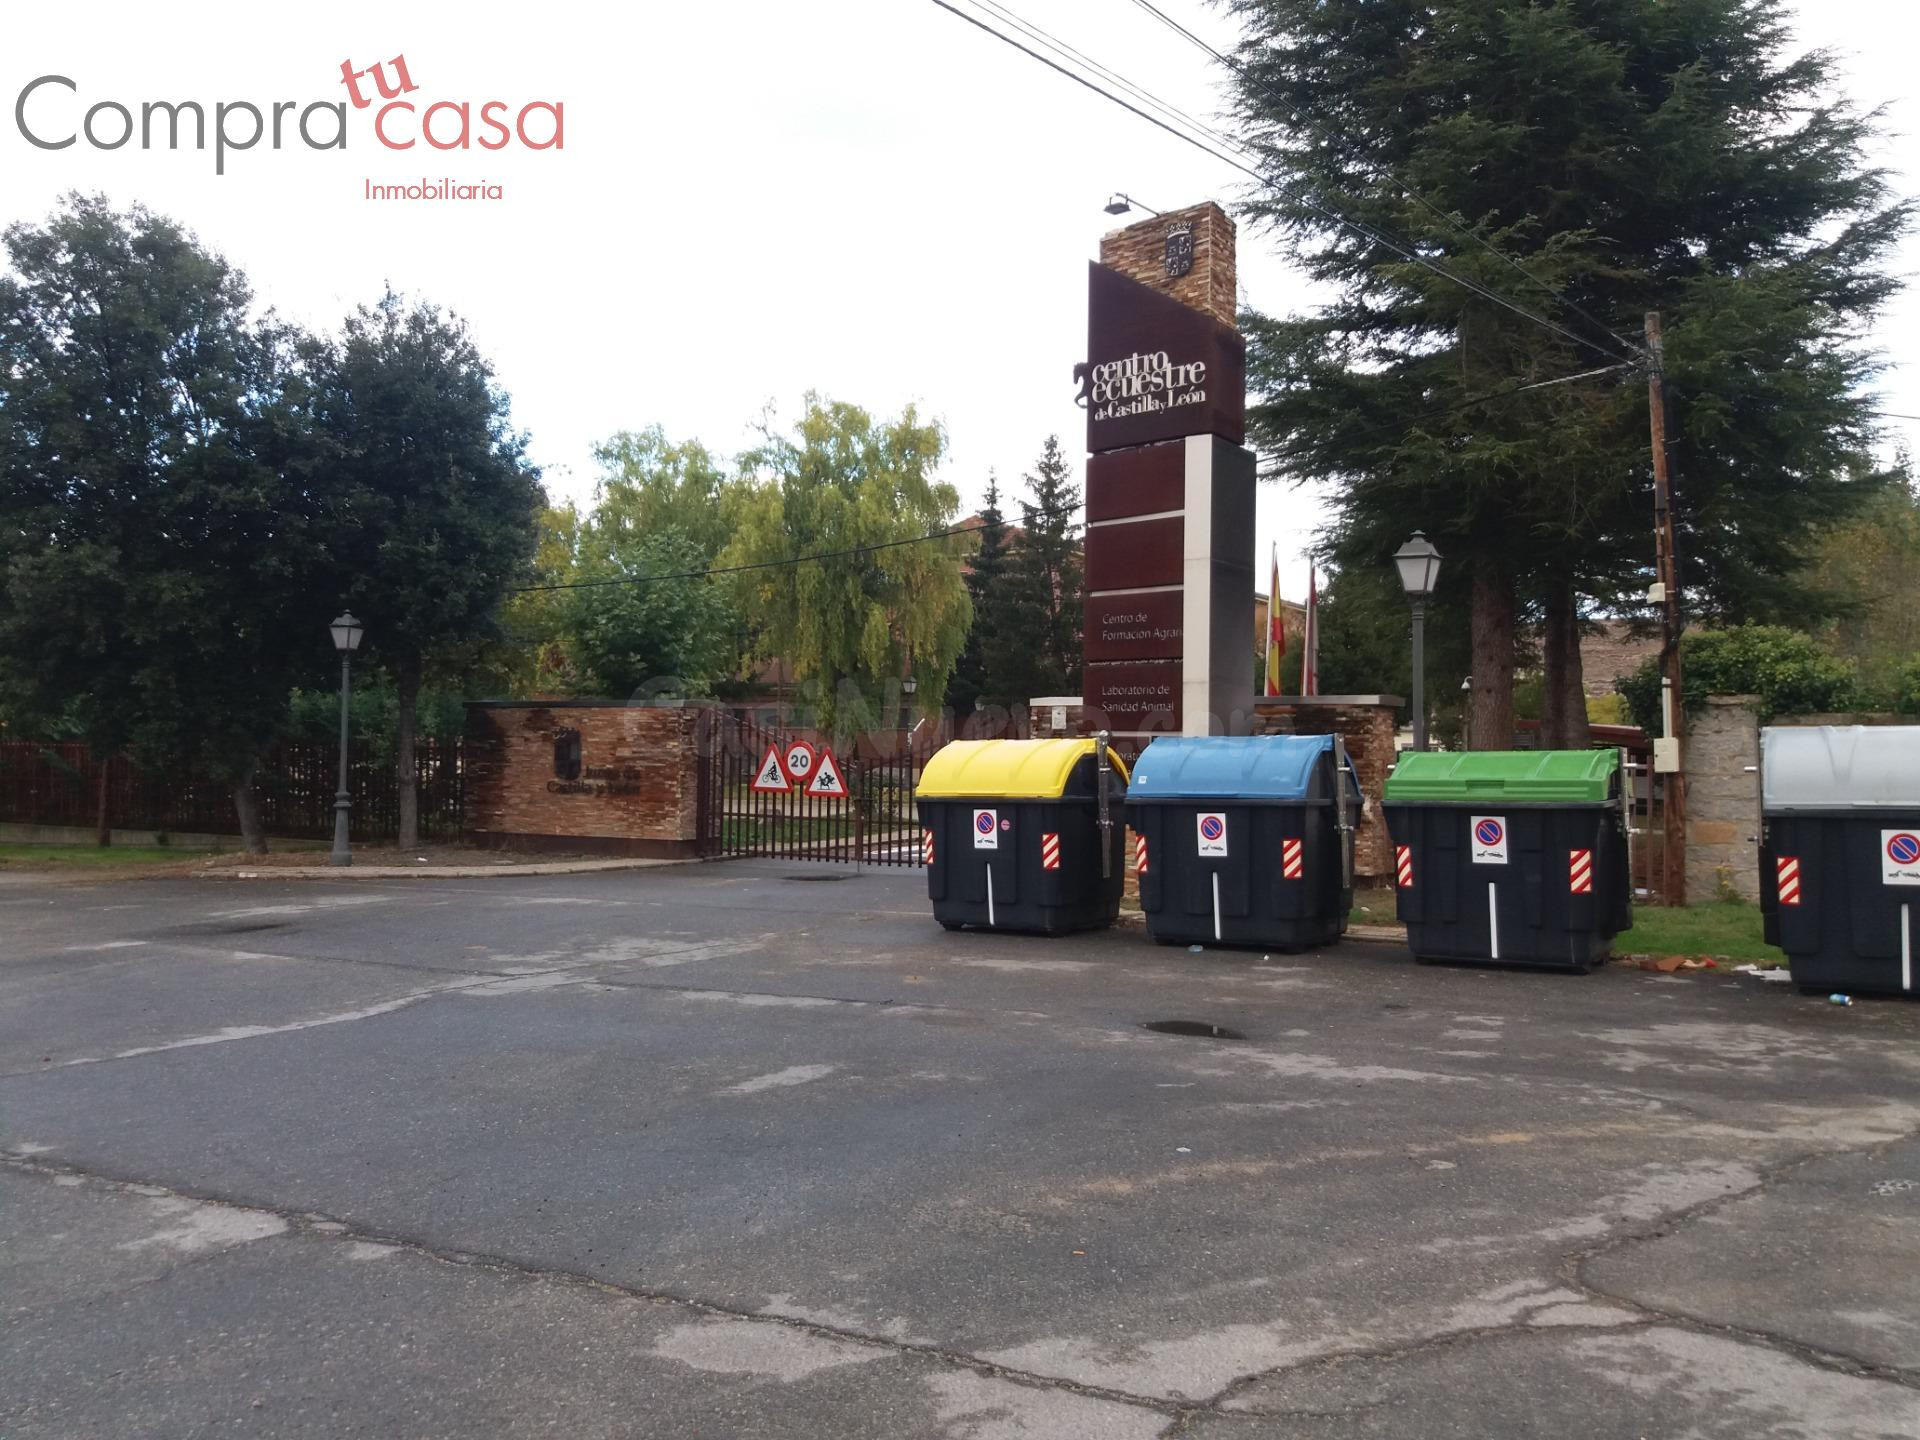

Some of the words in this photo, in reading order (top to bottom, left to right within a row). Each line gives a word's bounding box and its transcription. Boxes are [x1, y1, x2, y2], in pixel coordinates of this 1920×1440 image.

[1091, 351, 1168, 384] centro
[1091, 361, 1206, 403] ecuestre
[1094, 407, 1108, 422] de
[1107, 394, 1160, 418] Castilla
[1166, 385, 1206, 409] León
[1102, 612, 1134, 625] Centro
[1135, 612, 1148, 622] de
[1102, 685, 1156, 696] Laboratorio
[1157, 684, 1170, 695] de
[1102, 700, 1139, 712] Sanidad
[1141, 699, 1174, 712] Animal
[790, 754, 809, 768] 20
